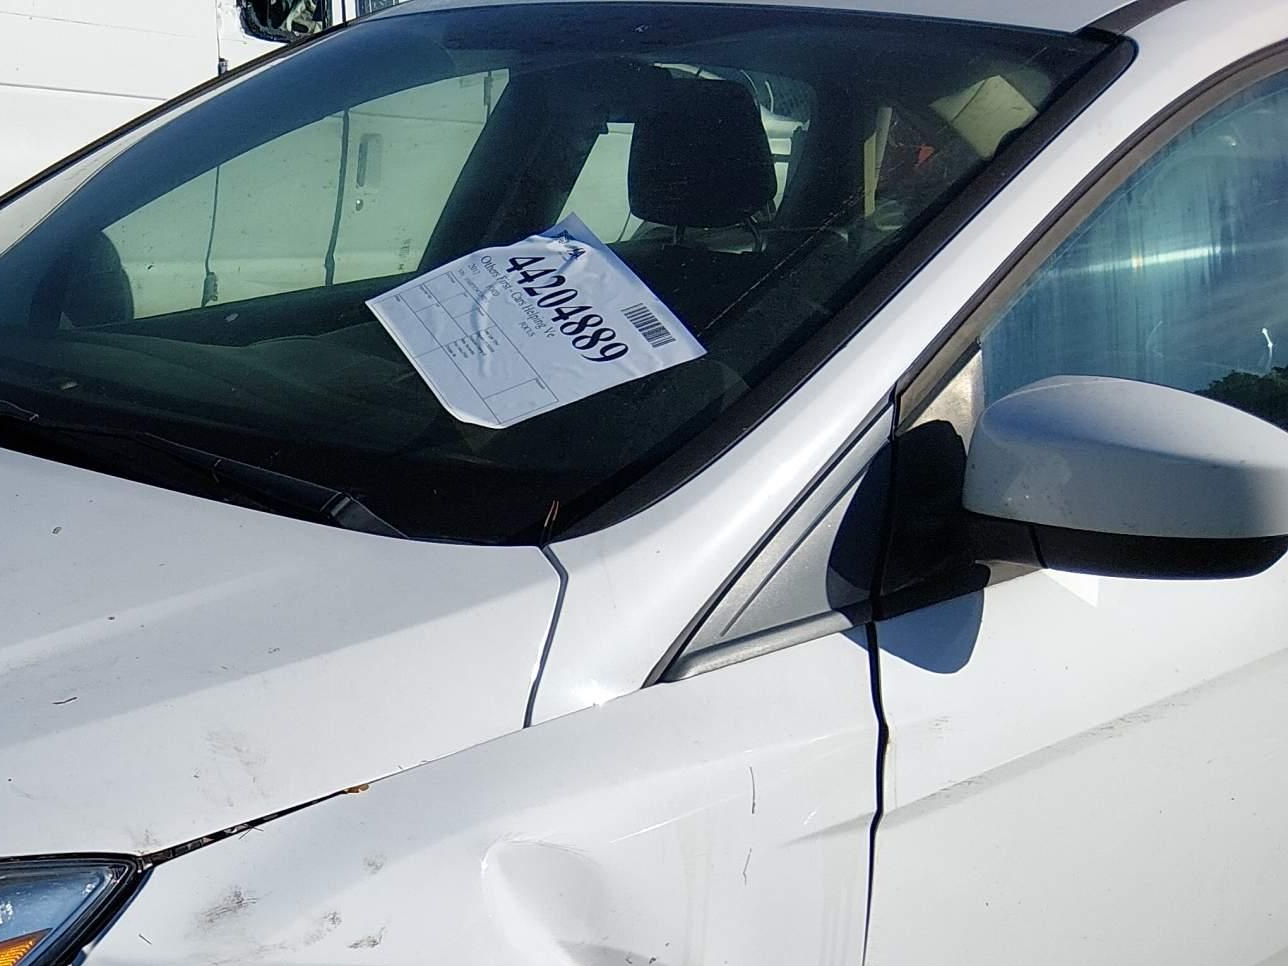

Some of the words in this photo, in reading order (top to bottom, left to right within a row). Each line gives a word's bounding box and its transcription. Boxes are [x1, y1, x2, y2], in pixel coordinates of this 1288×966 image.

[481, 255, 501, 280] Others
[497, 275, 511, 290] First
[511, 291, 525, 307] Cars
[522, 304, 547, 330] Helping
[505, 255, 629, 363] 44204889
